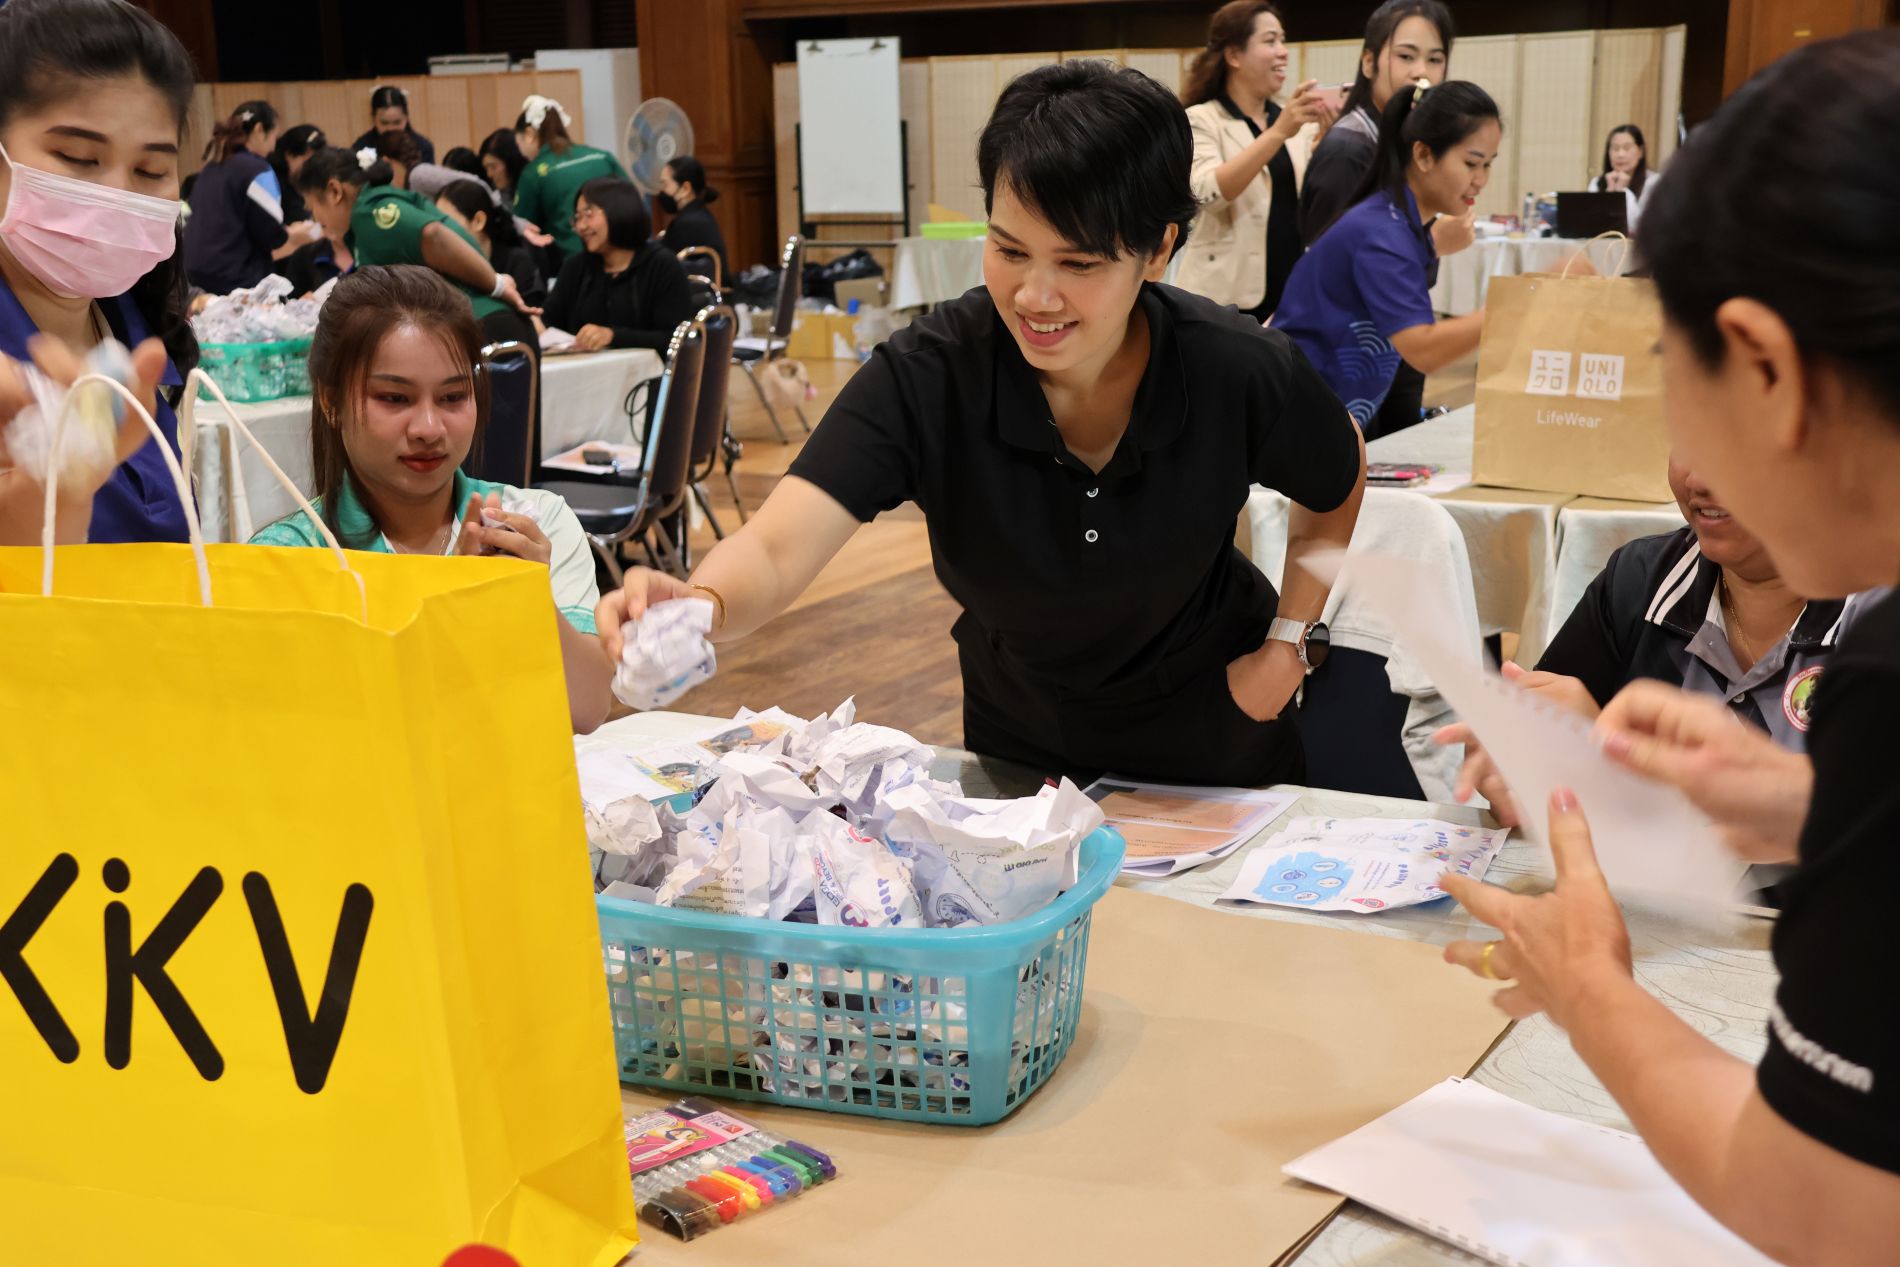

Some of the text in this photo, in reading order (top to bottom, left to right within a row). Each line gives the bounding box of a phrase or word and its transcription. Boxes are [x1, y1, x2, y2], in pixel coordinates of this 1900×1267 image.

[1585, 359, 1616, 376] UNI
[1583, 378, 1617, 395] QLO
[1536, 410, 1602, 428] LifeWear
